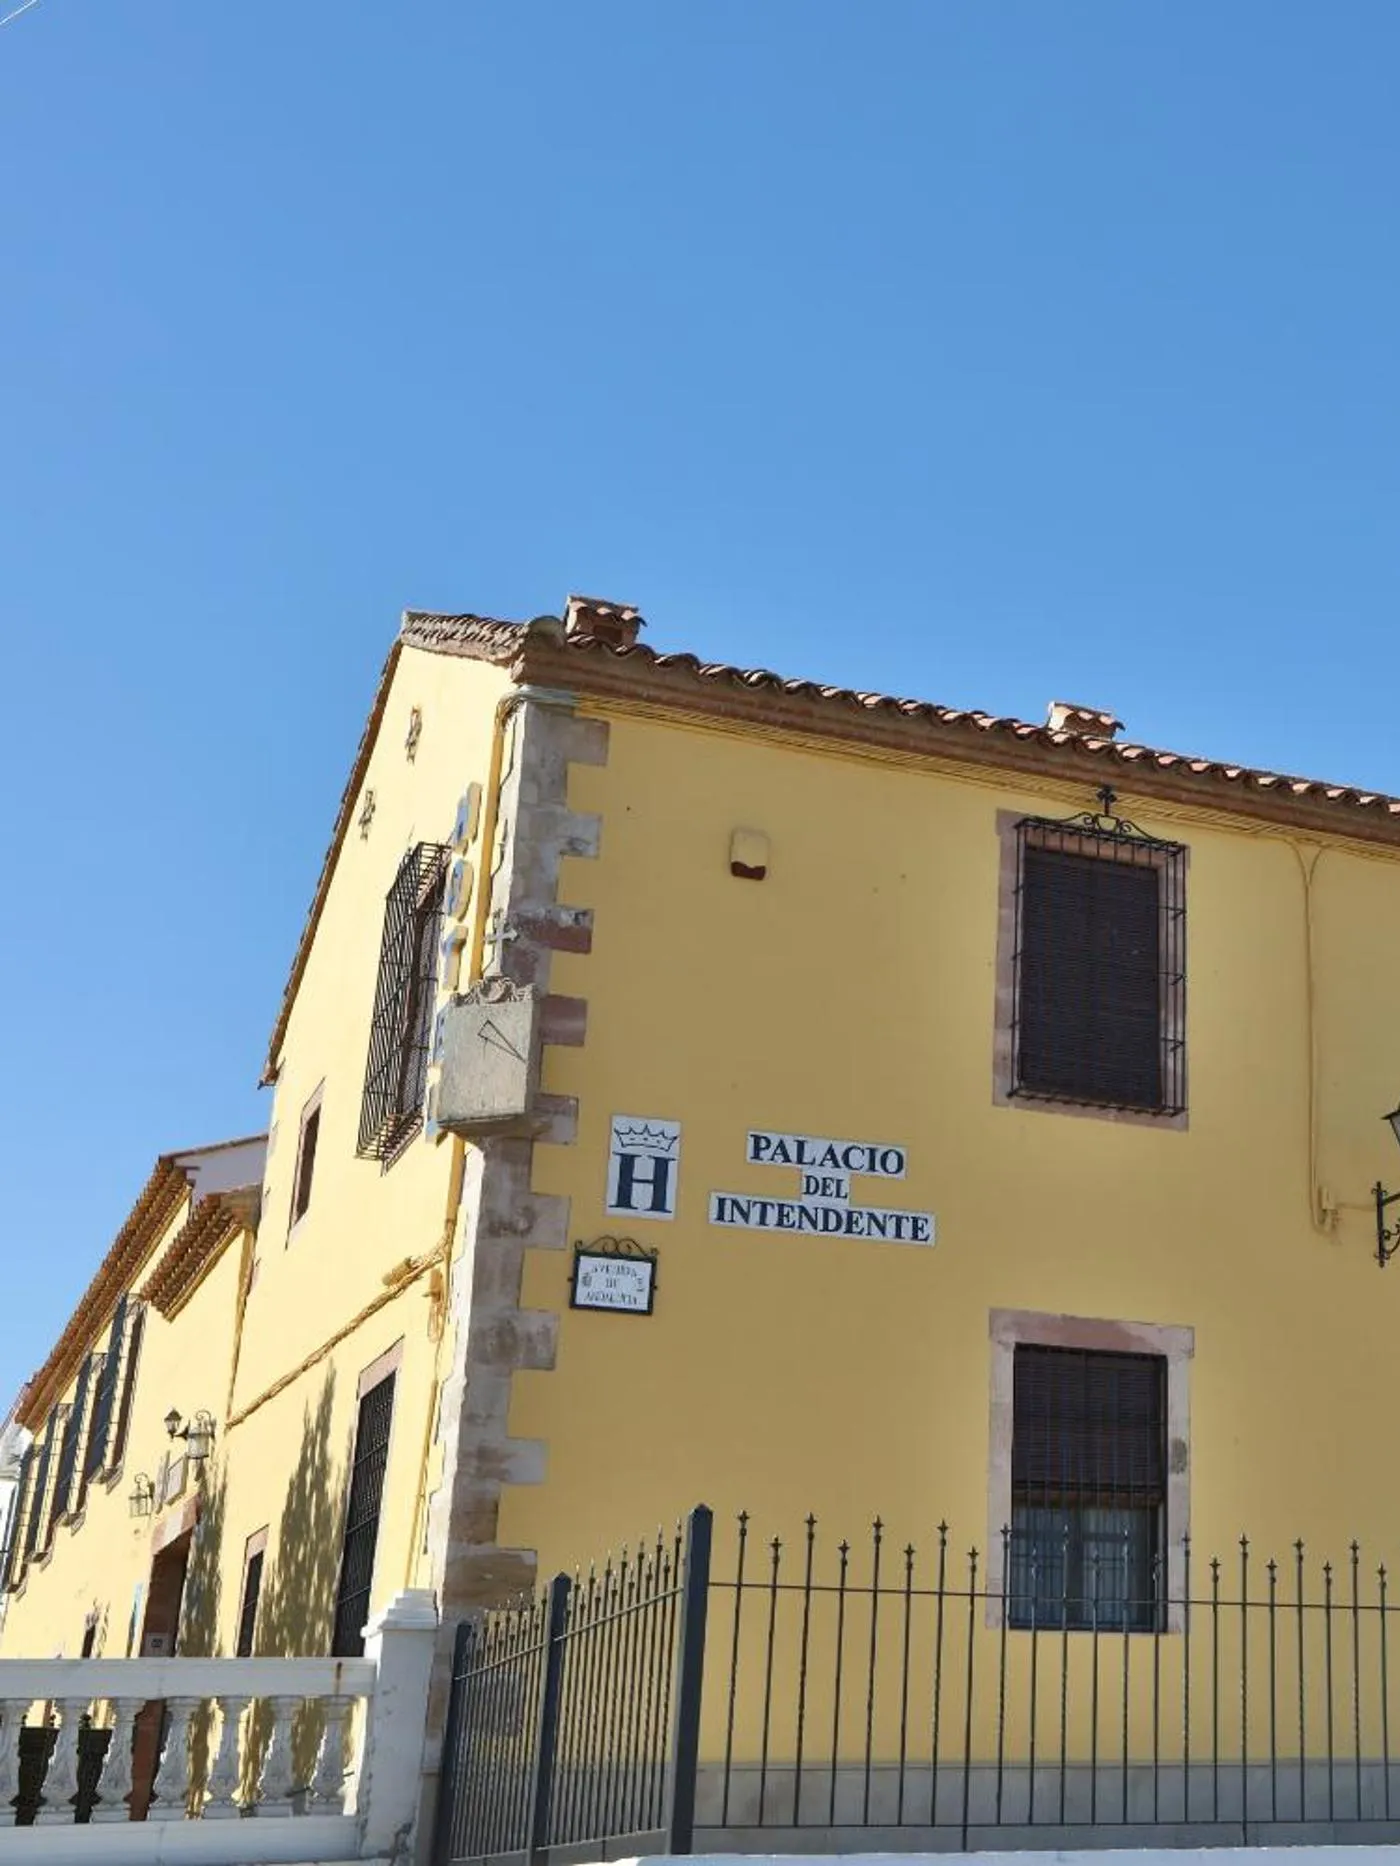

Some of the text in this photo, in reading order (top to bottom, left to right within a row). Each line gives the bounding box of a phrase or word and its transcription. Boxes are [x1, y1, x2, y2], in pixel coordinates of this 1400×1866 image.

[749, 1134, 905, 1175] PALACIO
[609, 1152, 676, 1213] H
[802, 1175, 848, 1199] DEL
[714, 1197, 930, 1242] INTENDENTE
